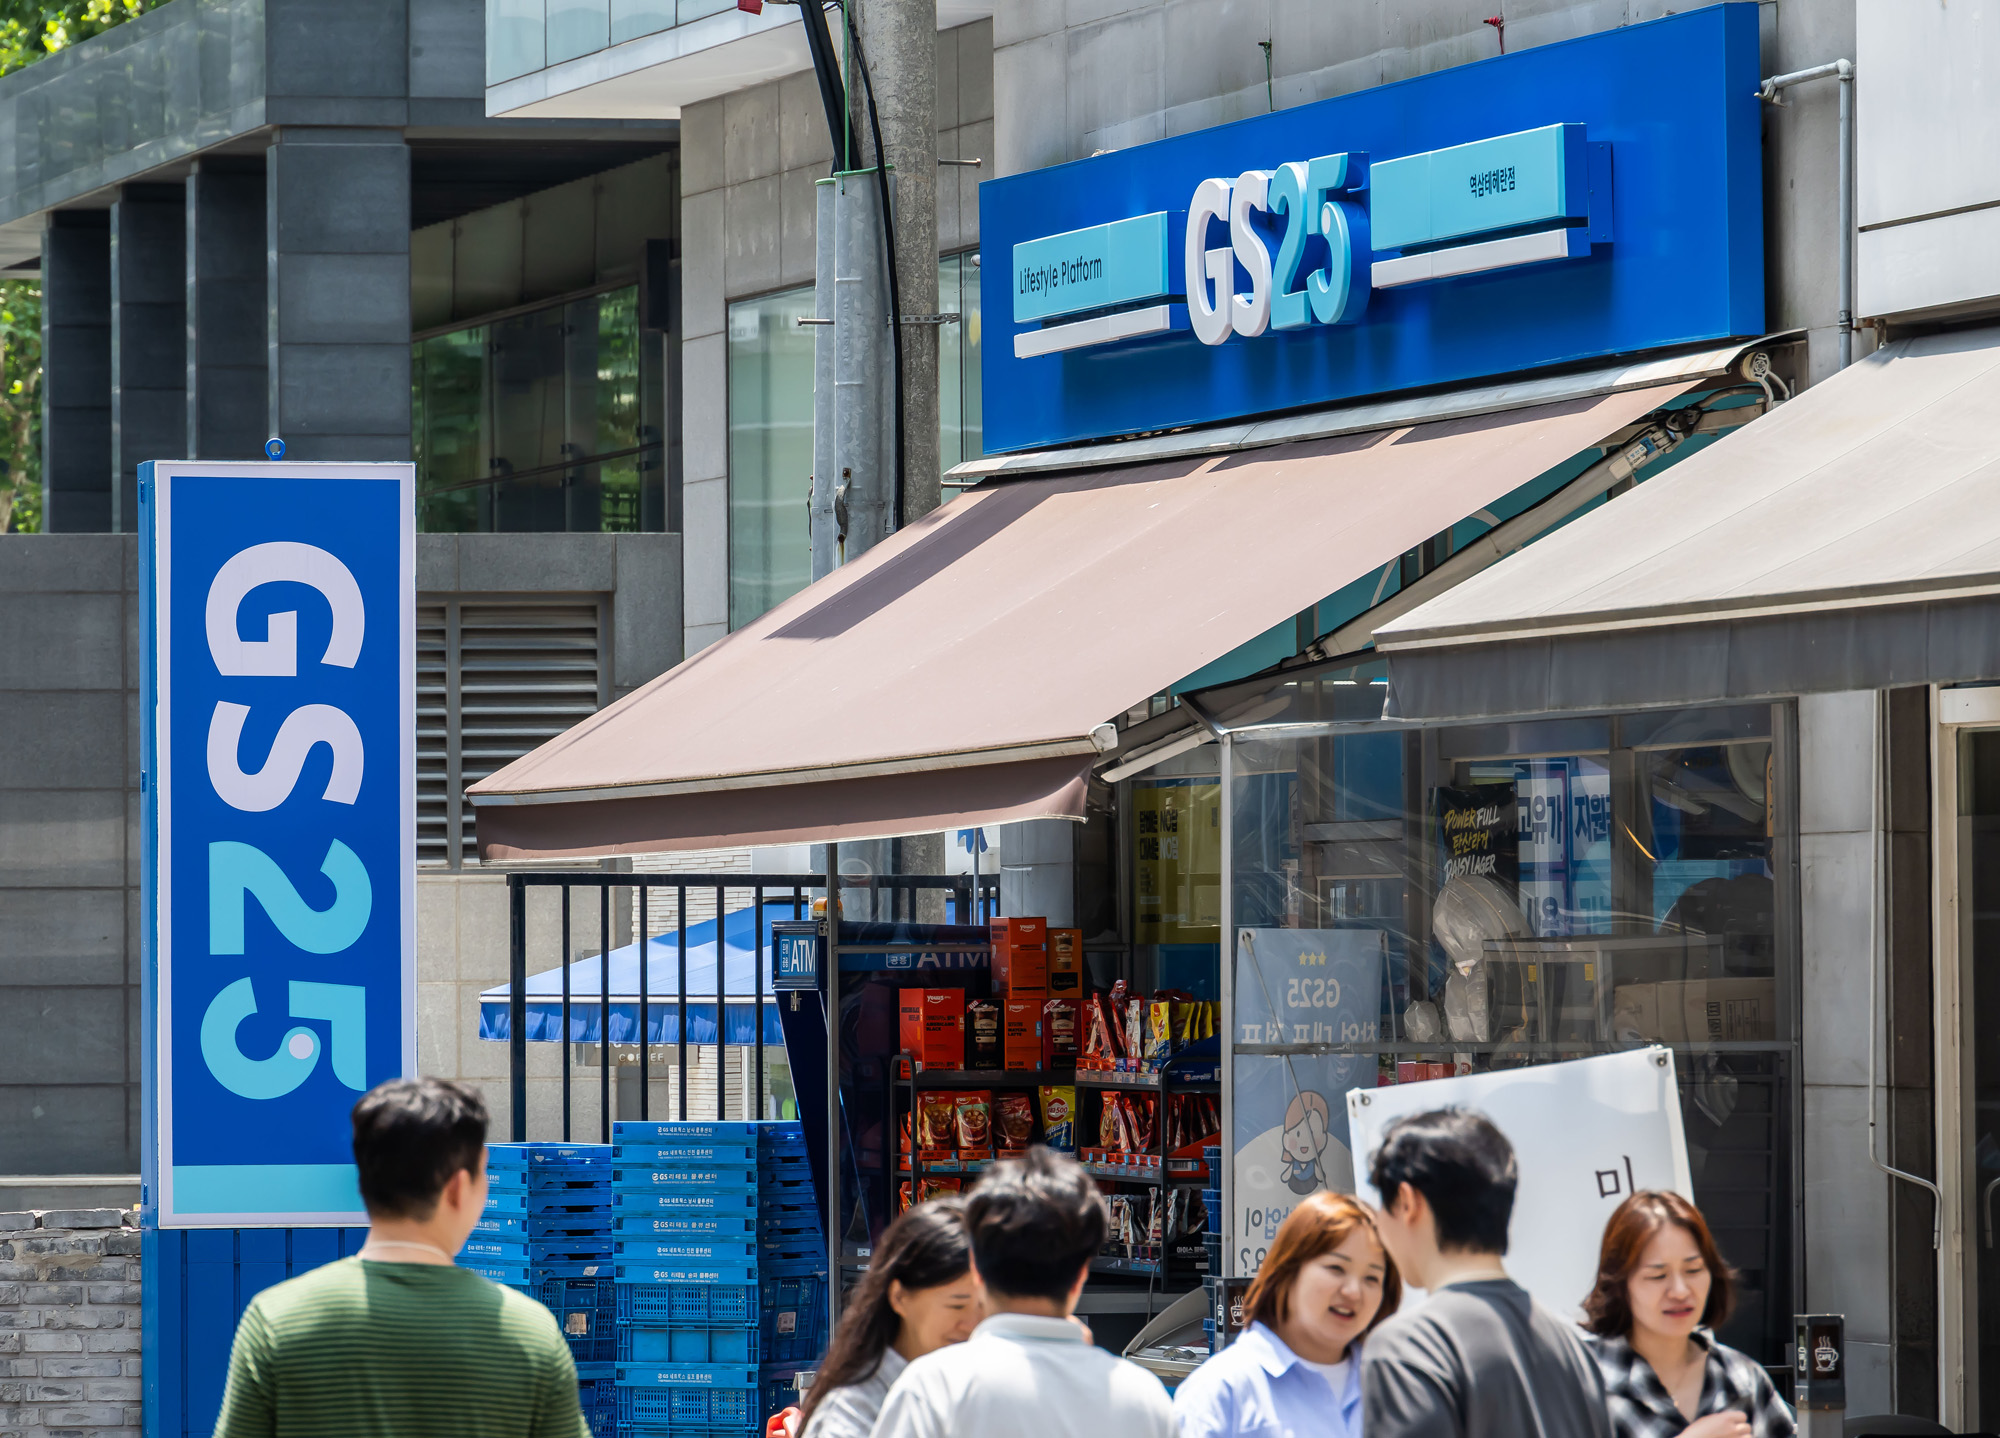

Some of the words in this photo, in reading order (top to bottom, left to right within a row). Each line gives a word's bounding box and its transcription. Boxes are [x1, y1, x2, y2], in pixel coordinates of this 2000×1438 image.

[1469, 165, 1516, 199] 역삼테헤란점
[1185, 152, 1352, 345] GS25
[1019, 263, 1058, 297] Lifestyle
[1061, 255, 1102, 286] Platform
[201, 541, 372, 1099] GS25
[1452, 829, 1489, 857] 탄산라거
[1470, 854, 1497, 876] LAGER
[791, 939, 816, 972] ATM
[917, 942, 989, 968] ATM
